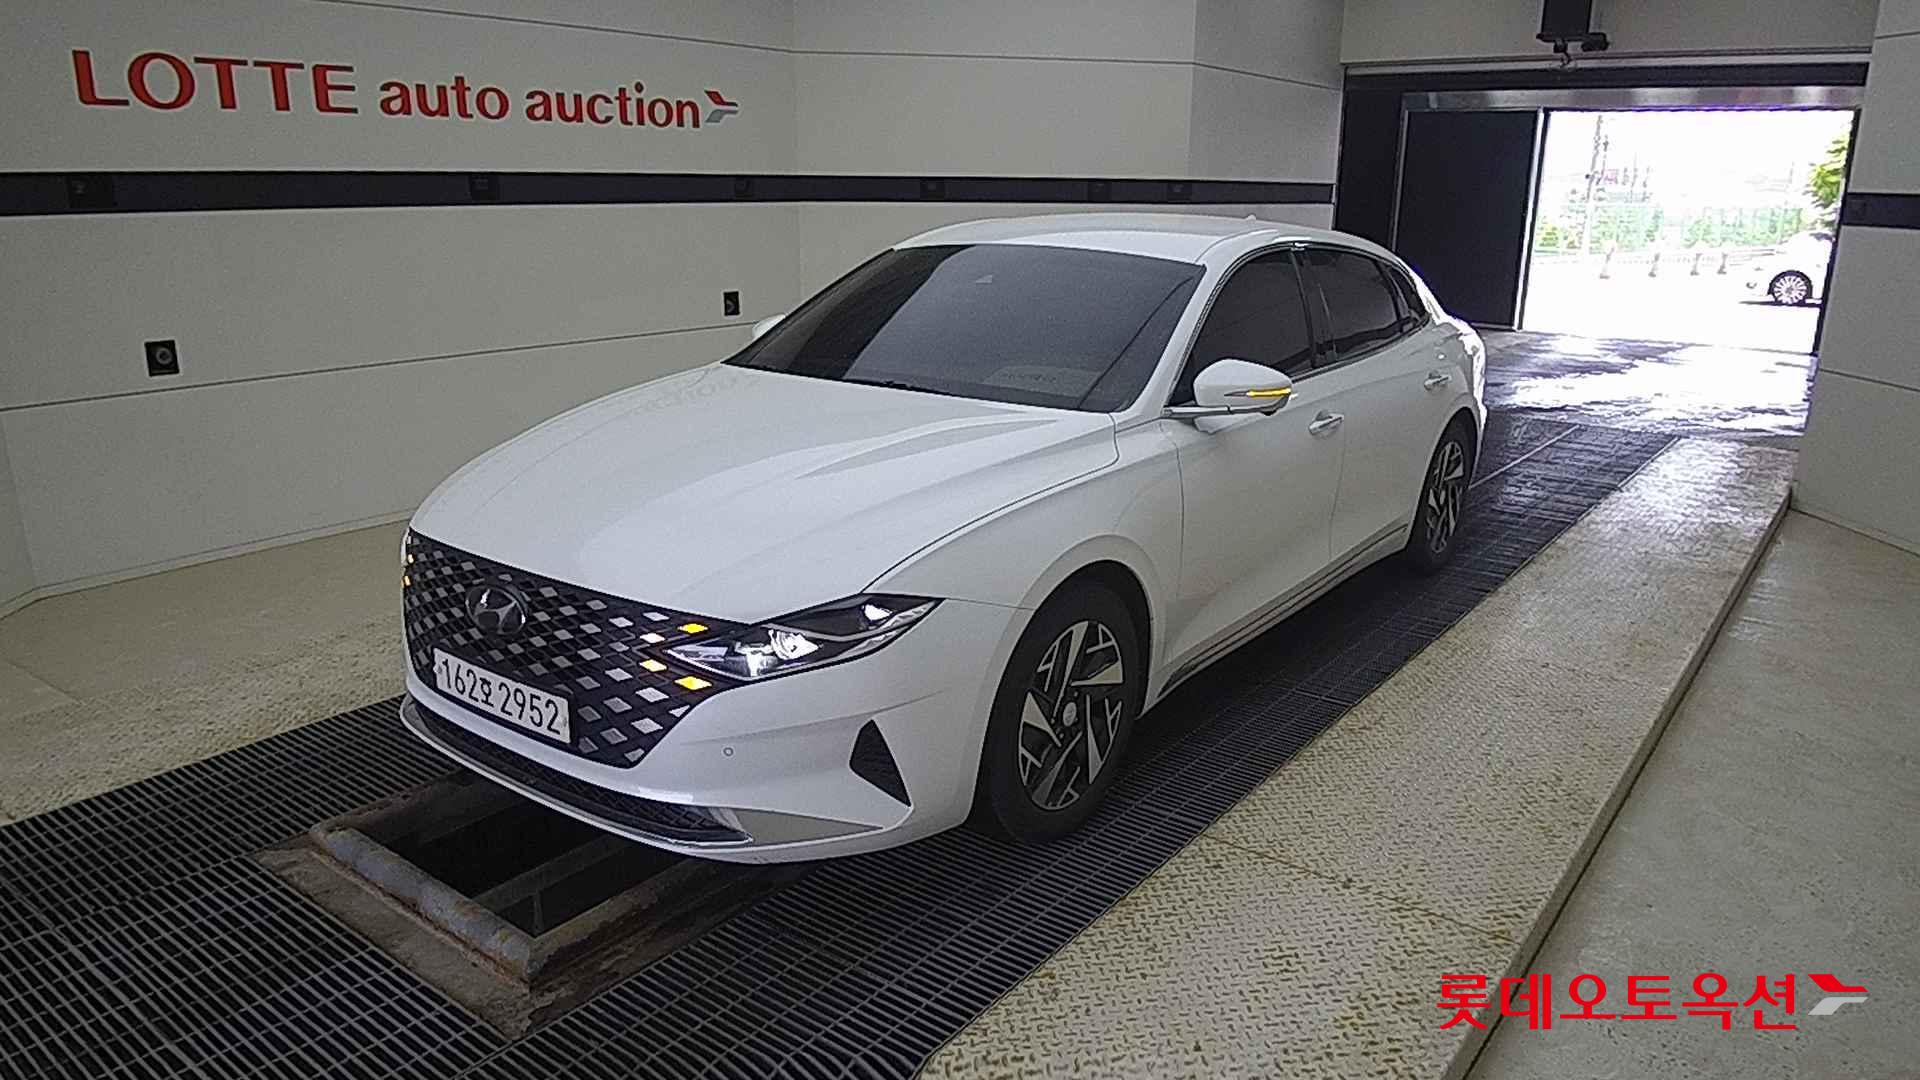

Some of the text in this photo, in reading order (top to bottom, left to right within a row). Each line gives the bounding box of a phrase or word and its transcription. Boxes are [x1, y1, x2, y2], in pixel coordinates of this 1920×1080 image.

[72, 50, 701, 129] LOTTE auto auction
[498, 681, 562, 736] 2952
